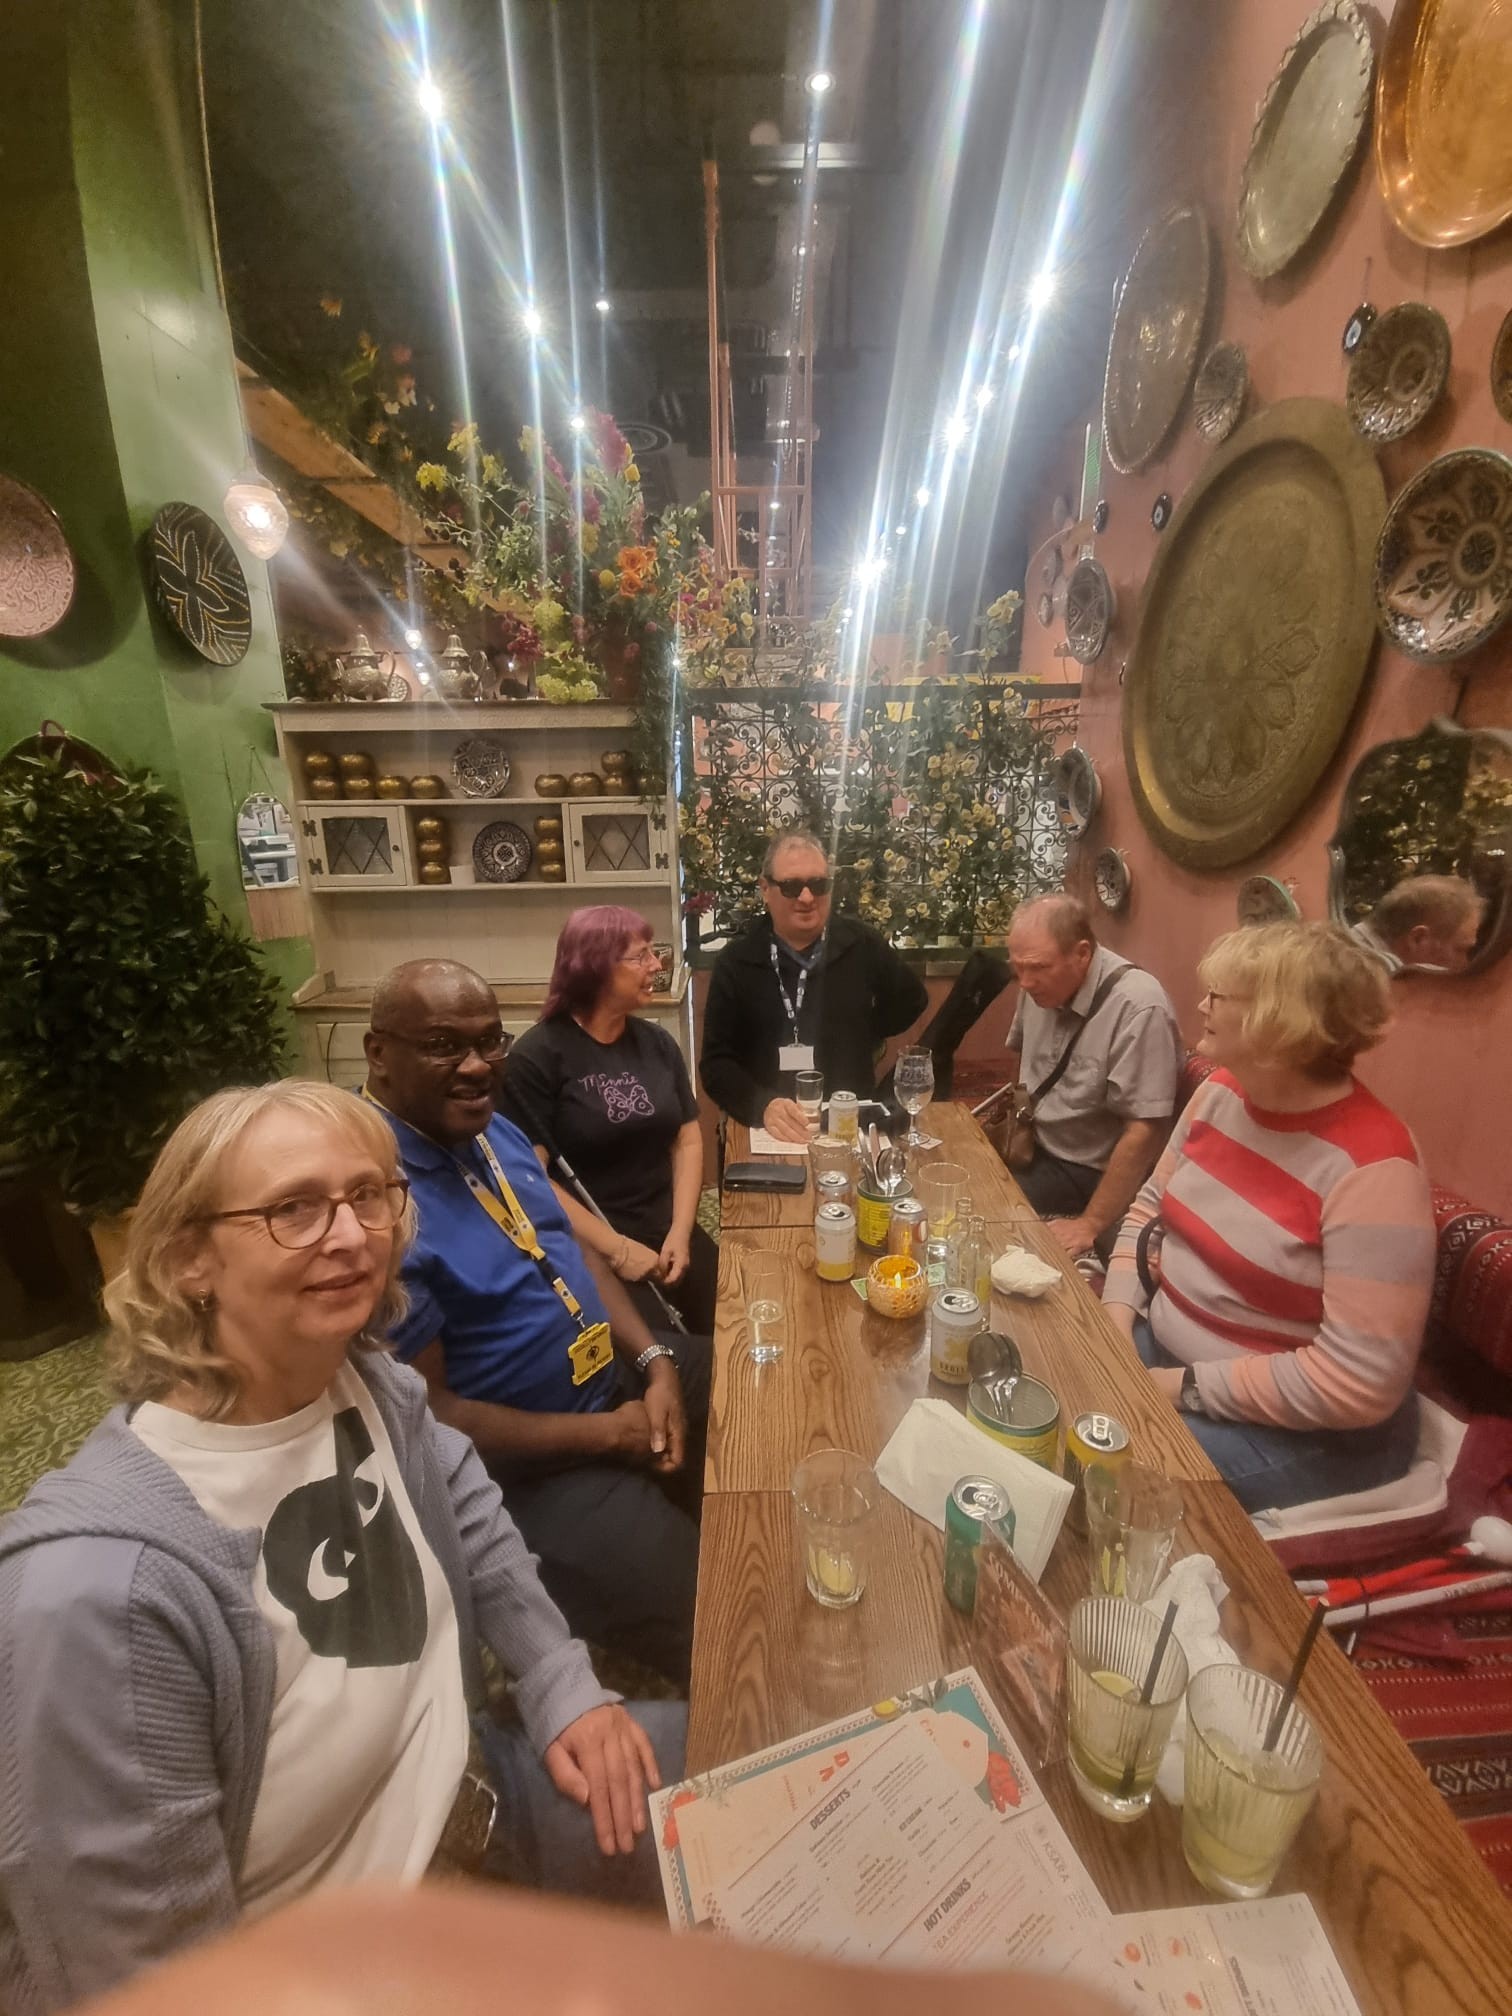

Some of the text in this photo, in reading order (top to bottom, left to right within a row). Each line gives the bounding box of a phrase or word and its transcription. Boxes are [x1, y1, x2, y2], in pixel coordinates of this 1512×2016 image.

[578, 1071, 639, 1096] Minnie
[809, 1787, 851, 1831] DESSERTS
[1041, 1841, 1070, 1884] KSARA
[923, 1907, 943, 1932] HOT
[940, 1877, 972, 1914] DRINKS
